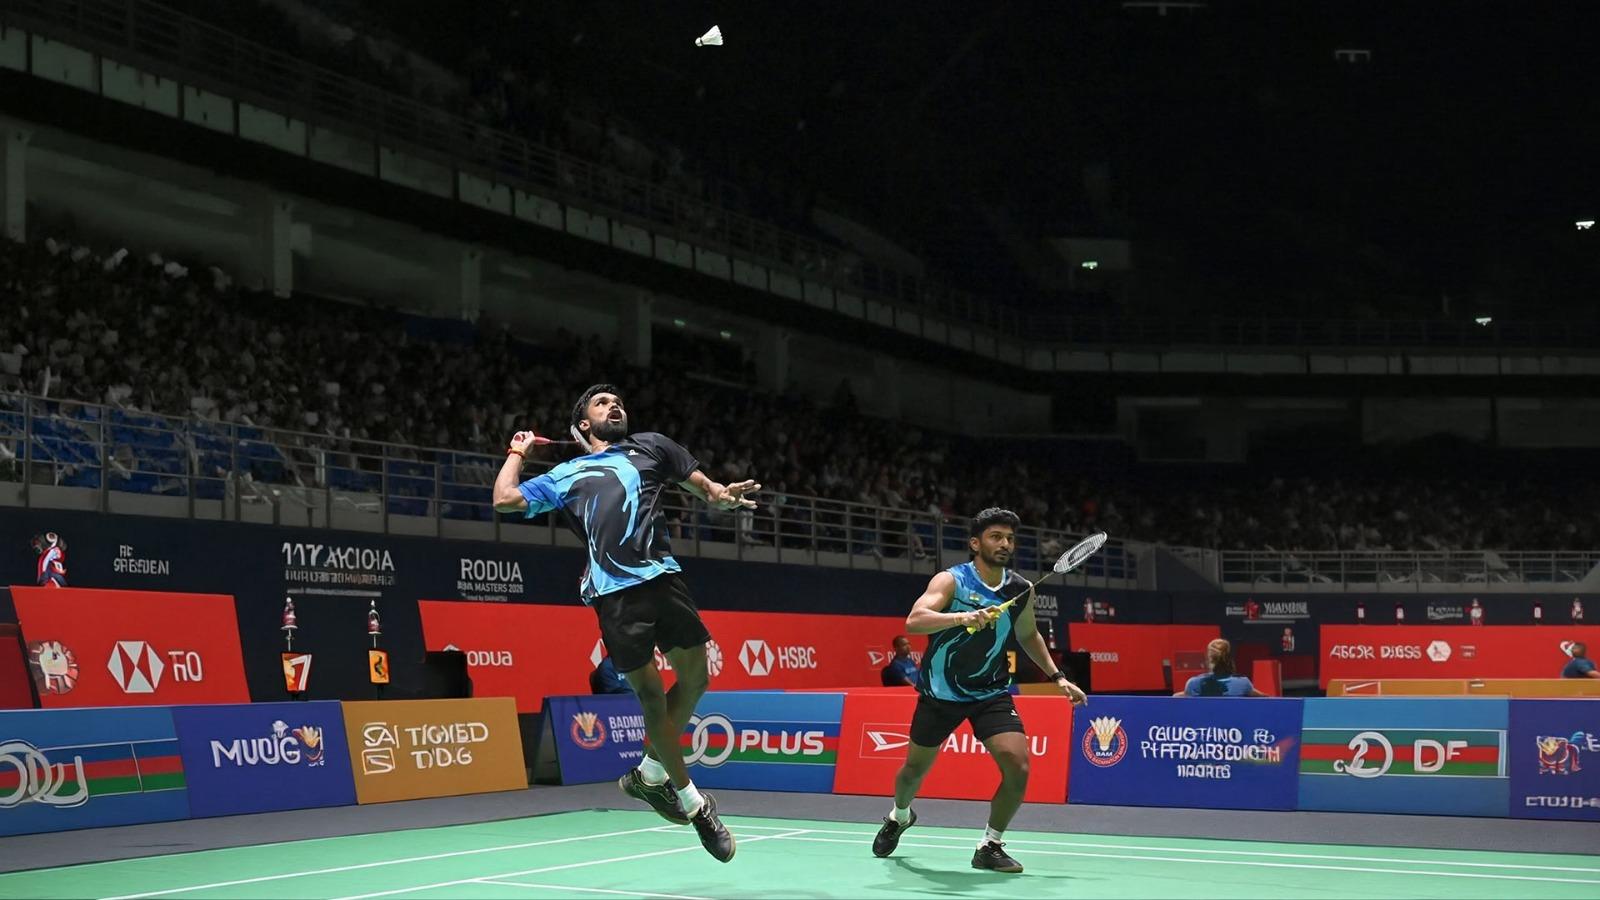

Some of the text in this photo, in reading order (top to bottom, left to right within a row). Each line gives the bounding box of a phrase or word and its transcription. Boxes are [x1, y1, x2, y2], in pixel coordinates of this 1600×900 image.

[461, 558, 523, 582] RODUA
[475, 582, 507, 593] MASTERS
[779, 647, 817, 669] HSBC
[611, 730, 625, 743] OF
[740, 730, 825, 756] PLUS
